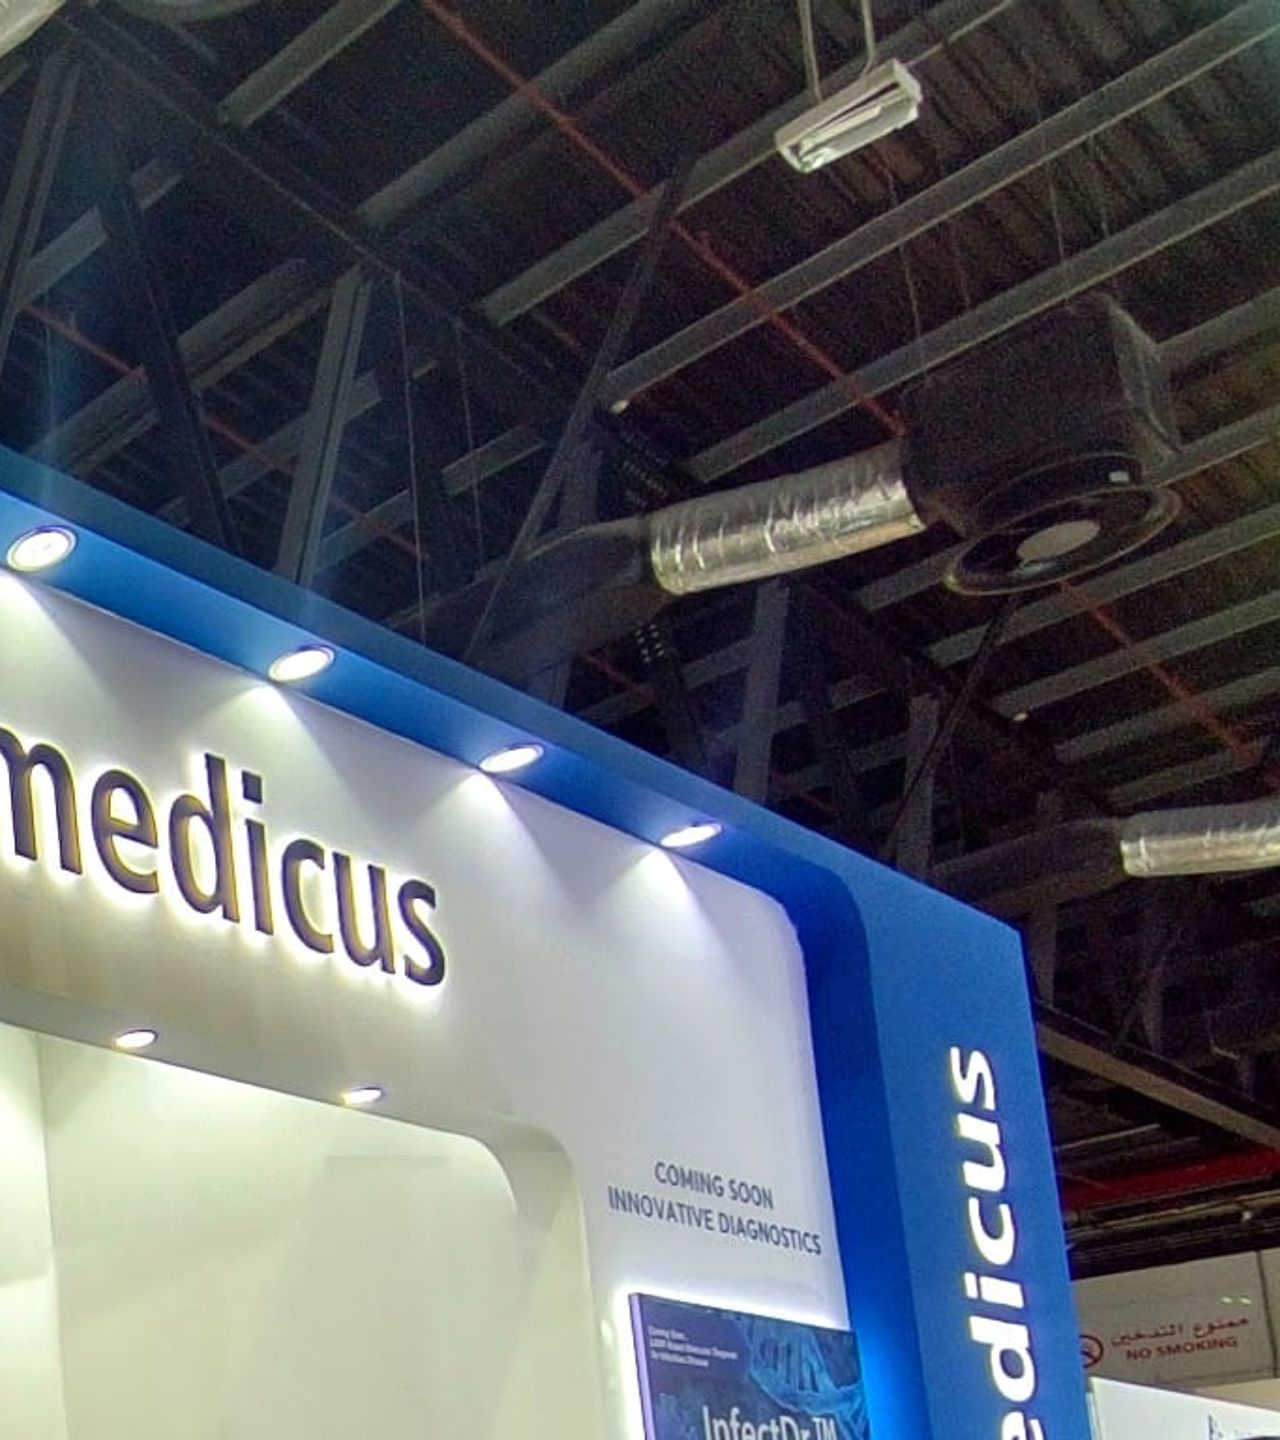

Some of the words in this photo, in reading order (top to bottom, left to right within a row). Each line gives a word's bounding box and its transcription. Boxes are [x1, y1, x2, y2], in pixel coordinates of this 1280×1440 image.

[655, 1161, 725, 1197] COMING
[729, 1179, 774, 1209] SOON
[607, 1185, 715, 1231] INNOVATIVE
[719, 1213, 823, 1255] DIAGNOSTICS
[1193, 1317, 1248, 1339] ممنوع
[1126, 1348, 1152, 1360] NO
[1157, 1337, 1238, 1356] SMOKING
